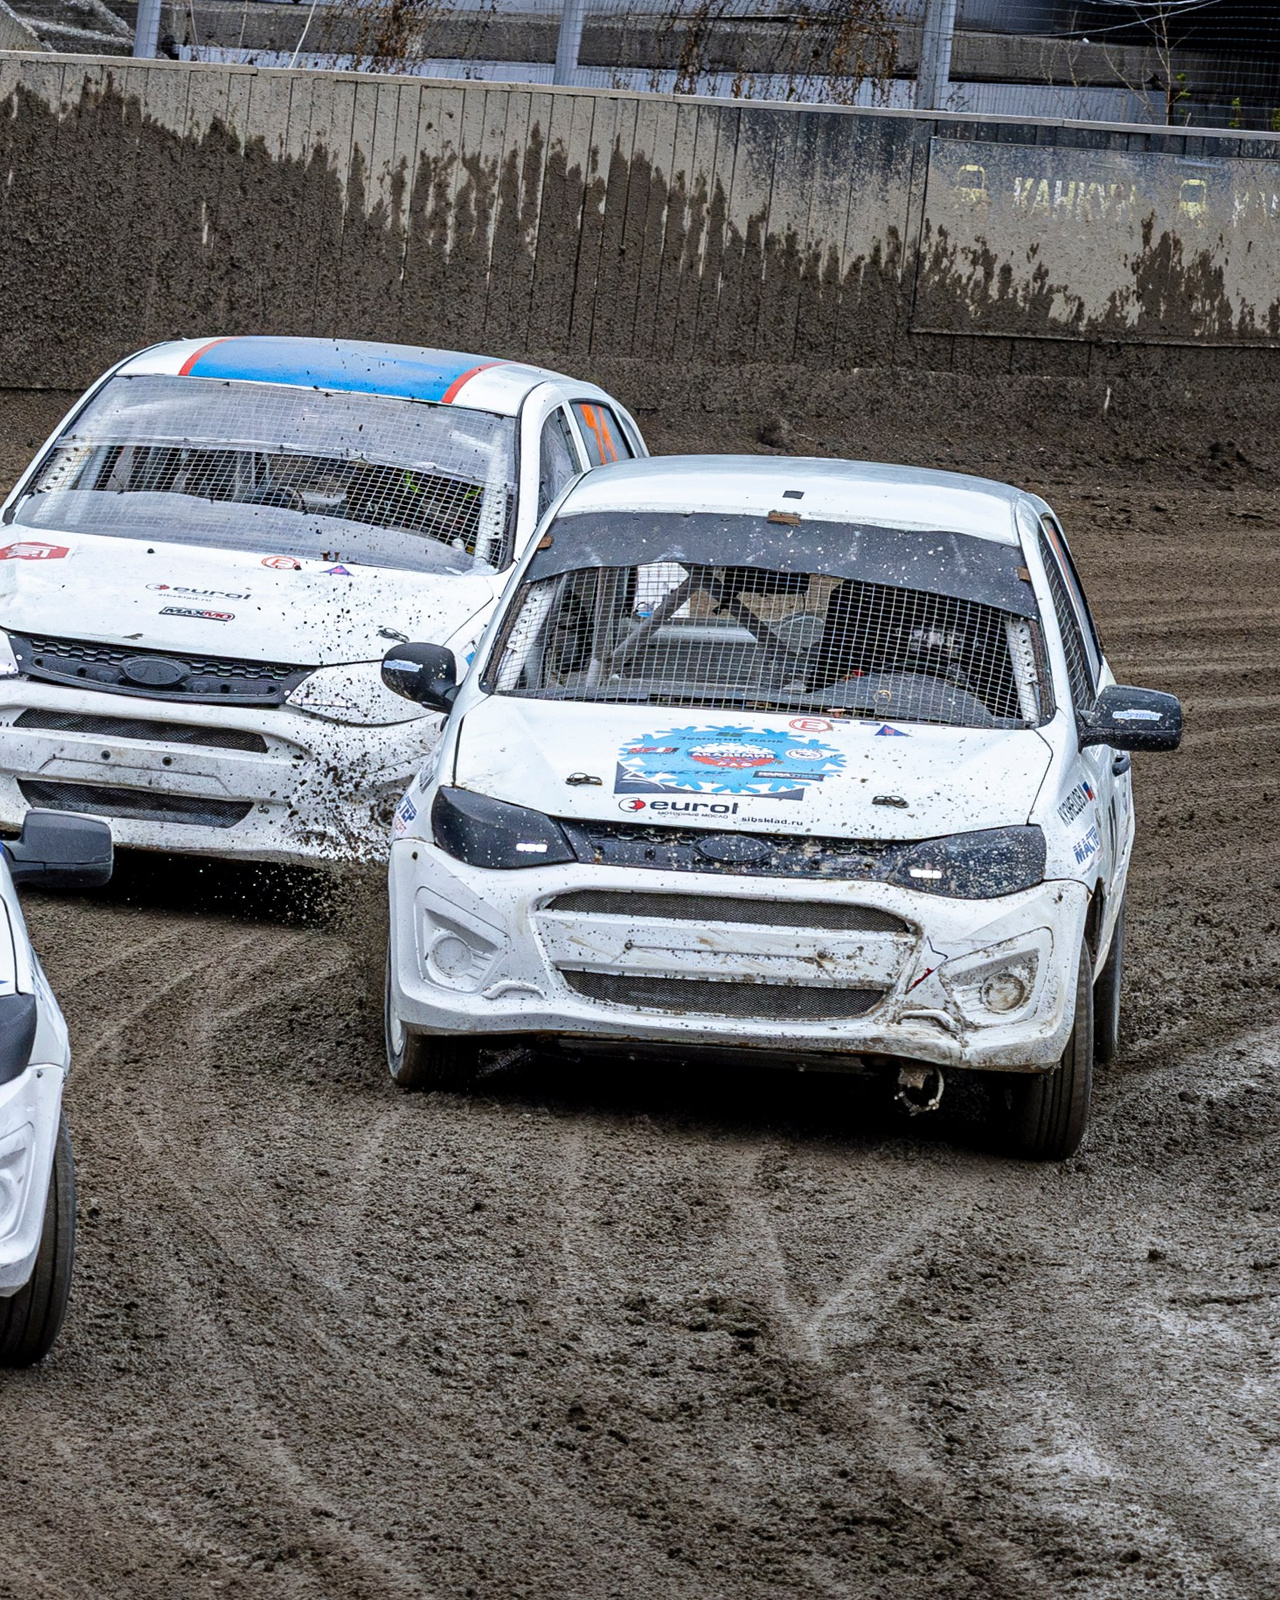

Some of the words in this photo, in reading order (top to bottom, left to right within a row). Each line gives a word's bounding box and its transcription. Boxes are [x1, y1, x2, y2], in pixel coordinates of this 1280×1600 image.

[172, 586, 252, 600] eurol
[649, 800, 739, 815] eurol
[741, 815, 804, 827] sibsklad.ru
